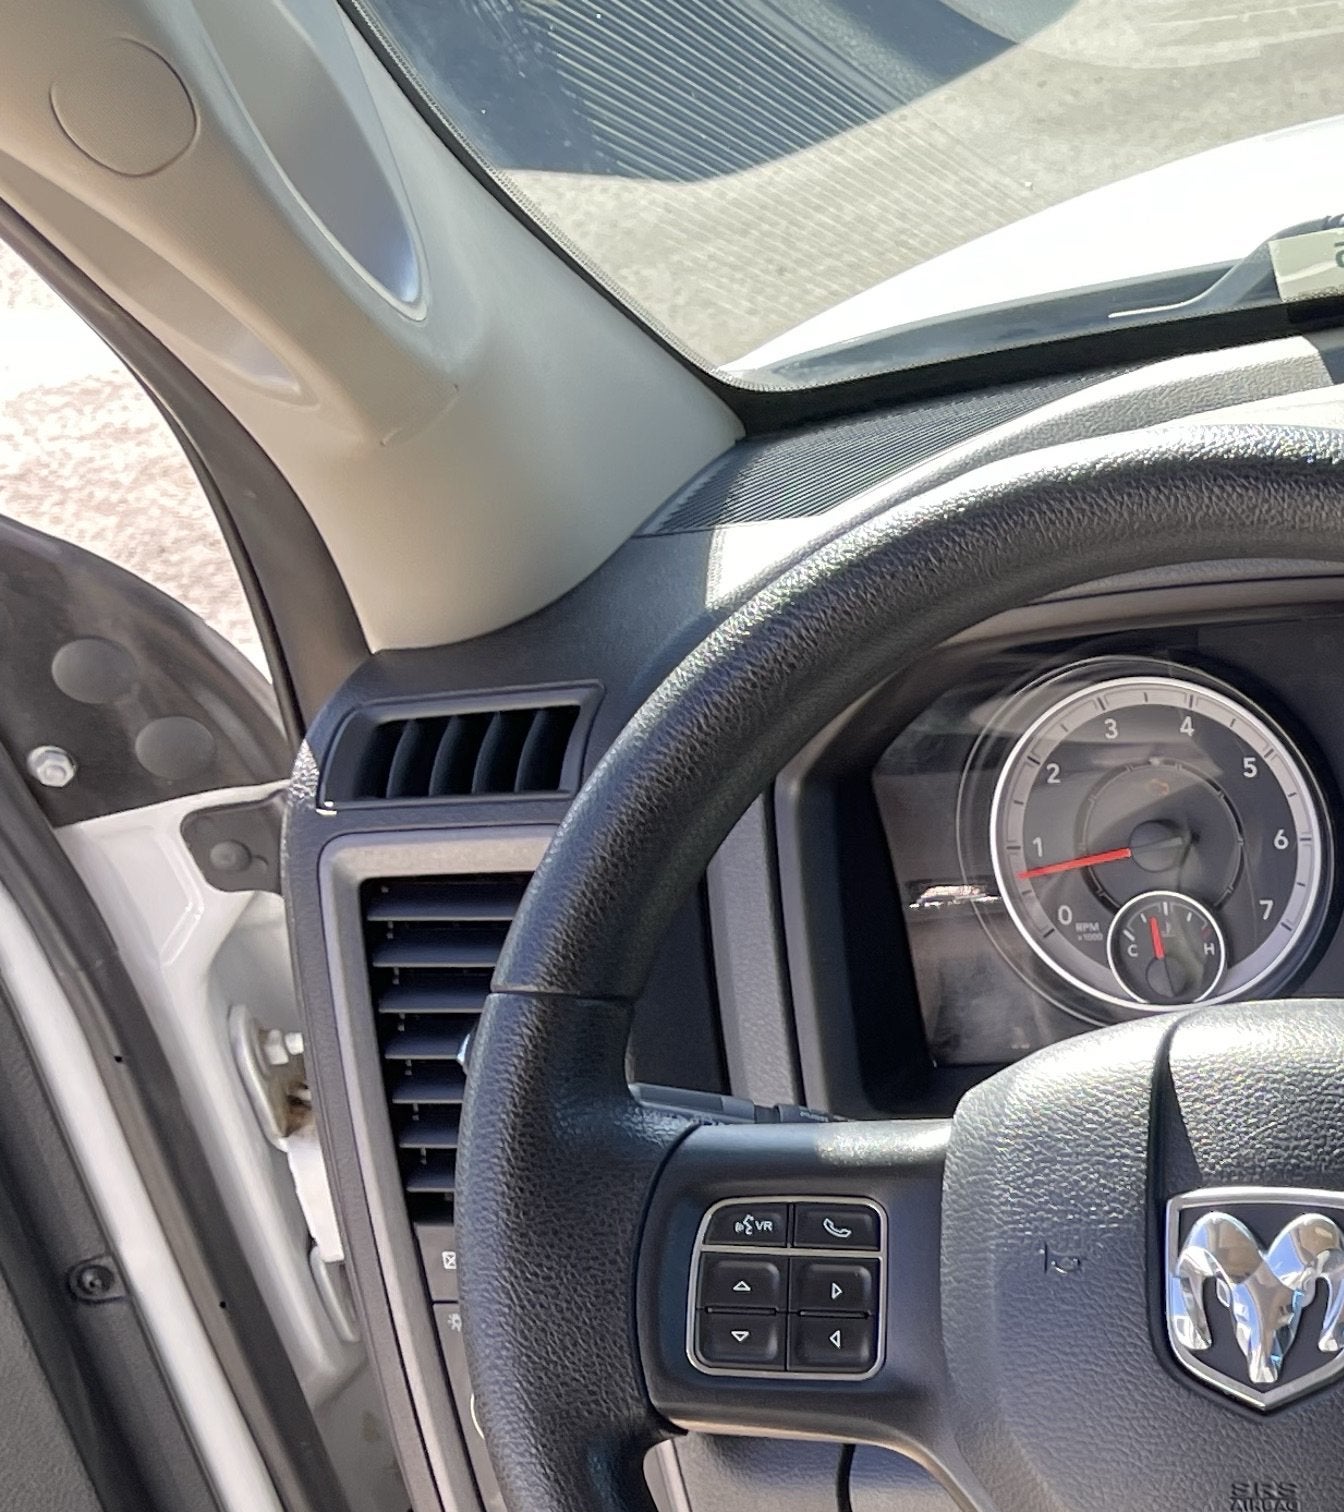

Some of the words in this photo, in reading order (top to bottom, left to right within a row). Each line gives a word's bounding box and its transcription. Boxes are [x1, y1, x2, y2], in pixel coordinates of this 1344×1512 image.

[1104, 719, 1118, 738] 3
[1179, 717, 1194, 736] 4
[1046, 763, 1060, 783] 2
[1242, 758, 1257, 777] 5
[1032, 837, 1043, 856] 1
[1273, 830, 1288, 849] 6
[1058, 905, 1072, 925] 0
[1260, 901, 1272, 919] 7
[1076, 922, 1099, 932] RPM
[1128, 944, 1139, 957] C
[1203, 943, 1215, 955] H
[755, 1221, 773, 1231] VR
